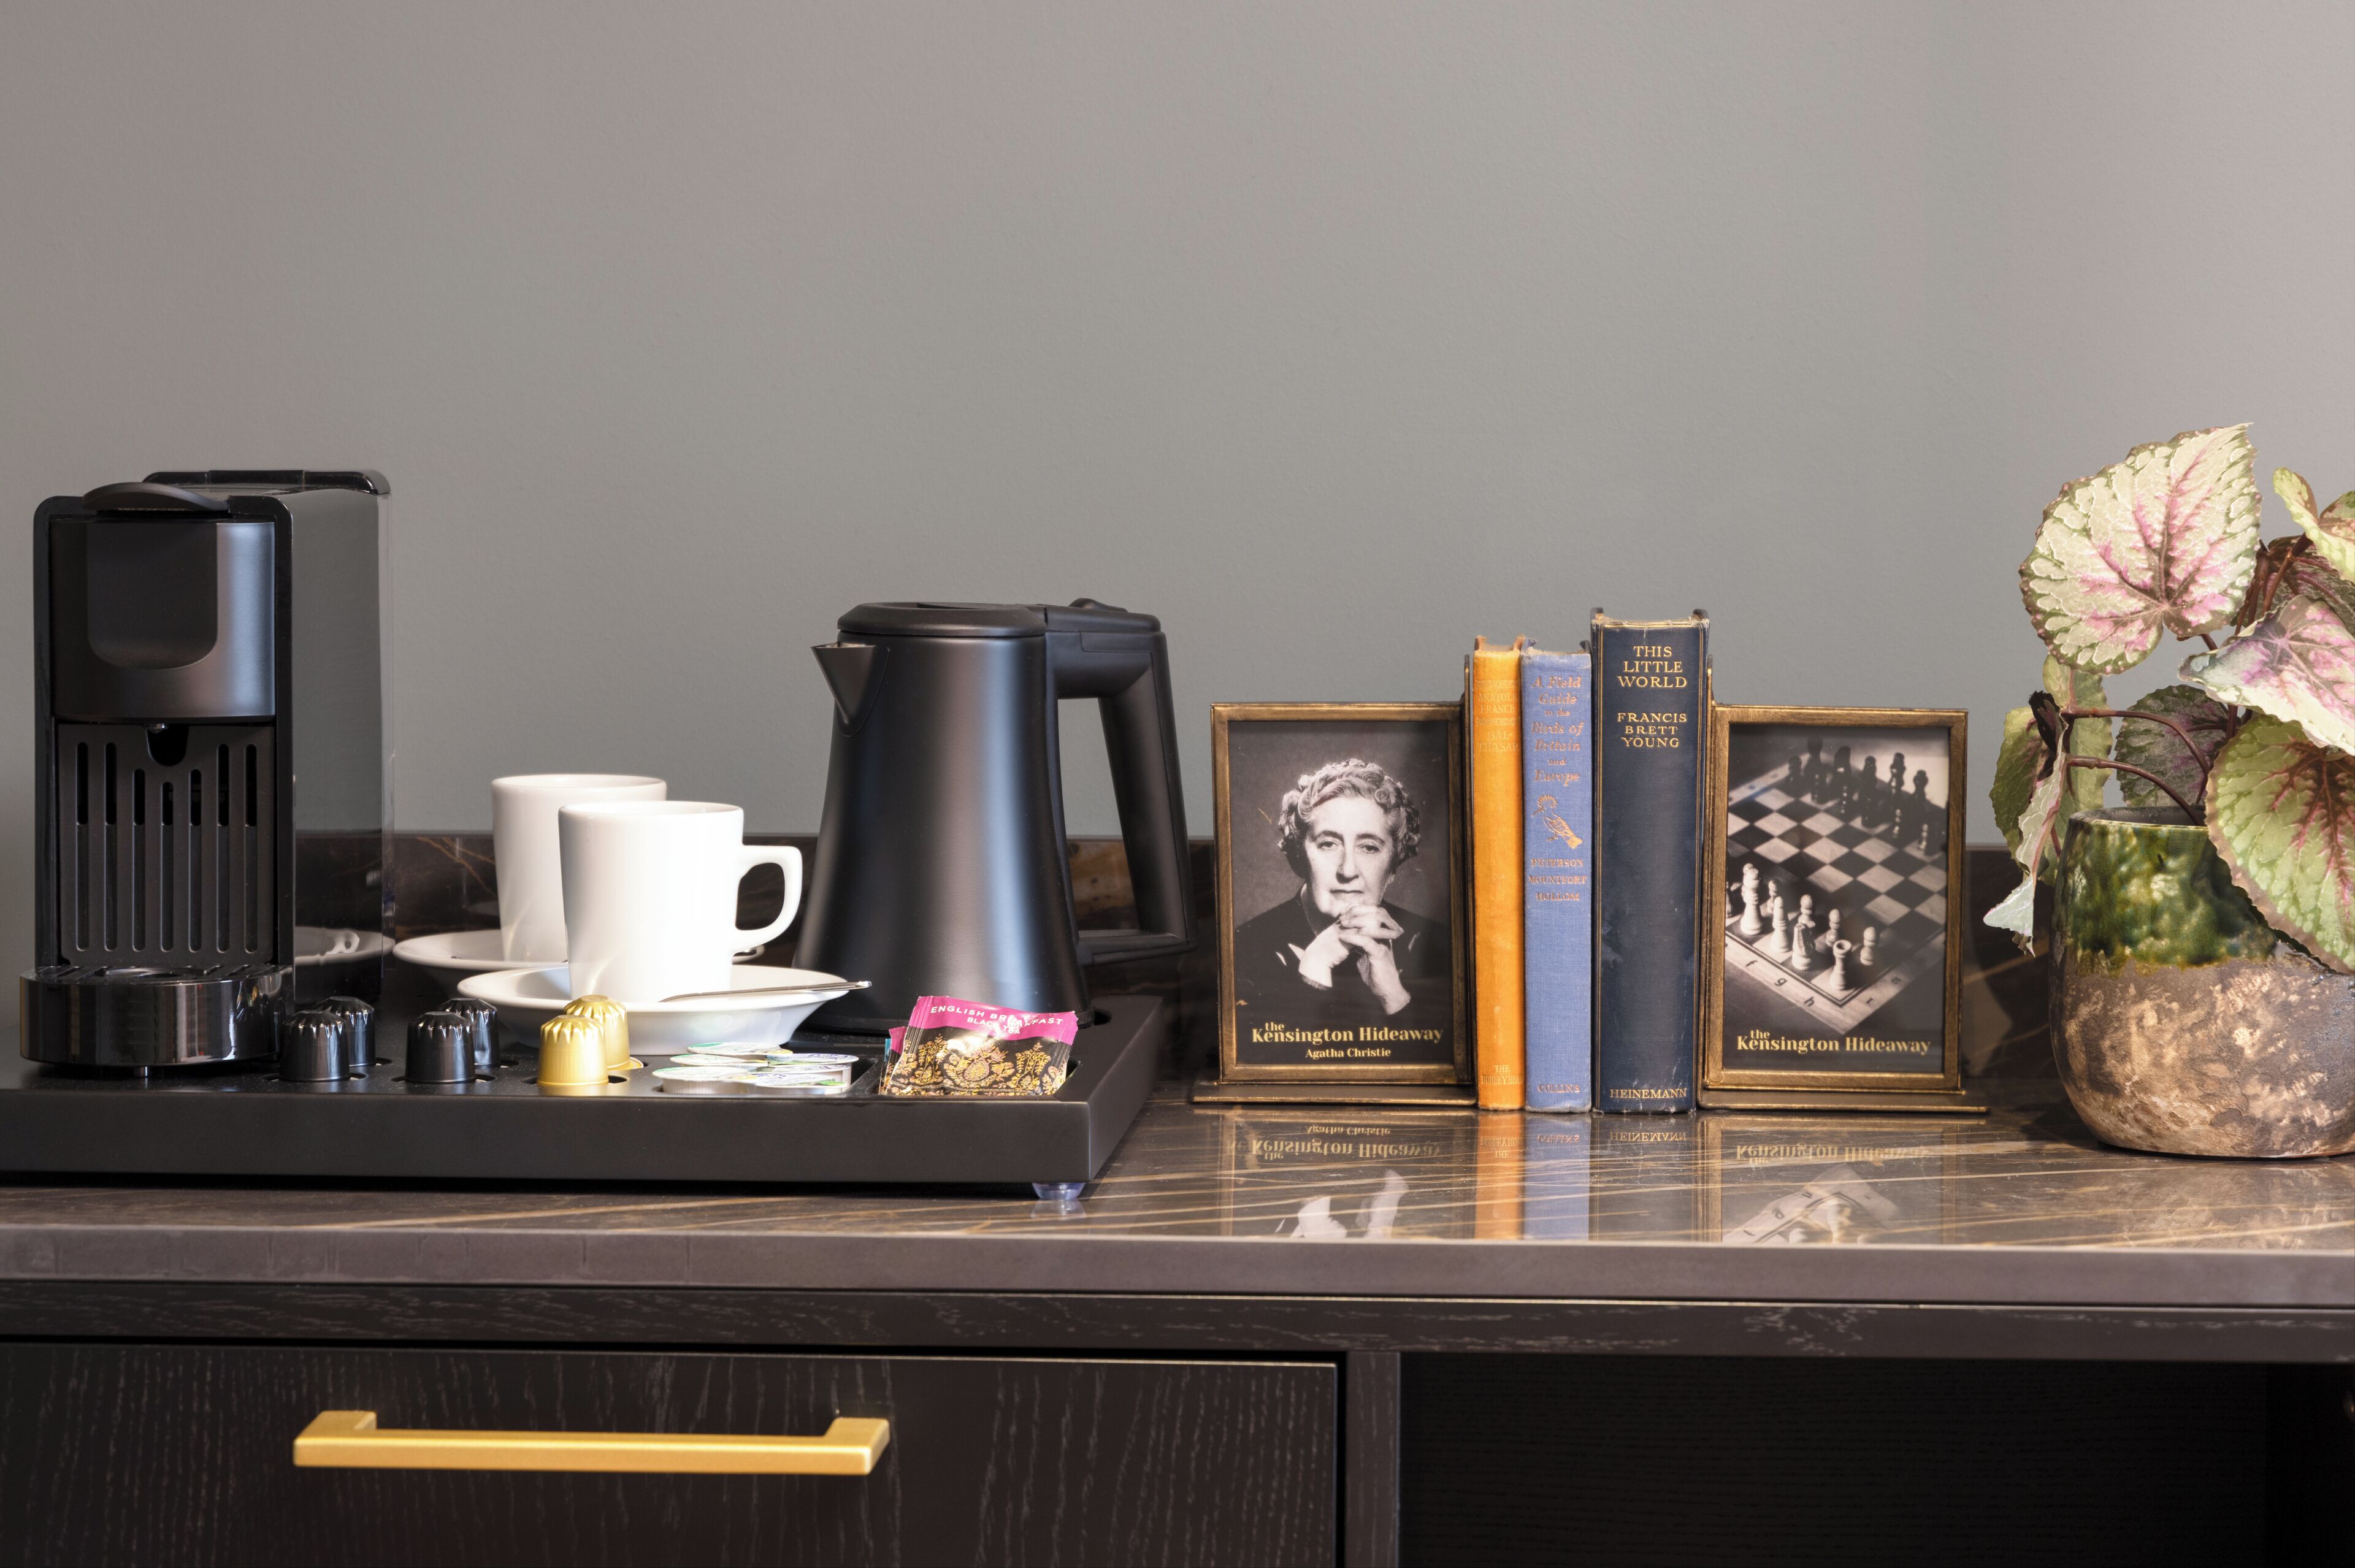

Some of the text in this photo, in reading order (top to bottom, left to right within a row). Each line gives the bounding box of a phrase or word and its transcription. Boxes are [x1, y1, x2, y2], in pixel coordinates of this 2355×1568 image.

[1633, 646, 1672, 657] THIS
[1623, 660, 1683, 673] LITTLE
[1531, 676, 1582, 687] A Field
[1617, 676, 1687, 688] WORLD
[1479, 692, 1517, 702] ANATOLE
[1538, 691, 1578, 704] Guide
[1480, 704, 1515, 713] FRANCE
[1617, 713, 1687, 723] FRANCIS
[1531, 721, 1585, 736] Birds of
[1625, 725, 1678, 735] BRETT
[1534, 739, 1580, 751] Britain
[1620, 737, 1680, 748] YOUNG
[1534, 769, 1580, 786] Europe
[1531, 858, 1583, 867] PETERSON
[930, 1005, 985, 1017] ENGLISH
[1265, 1022, 1285, 1032] the
[1252, 1027, 1444, 1046] Kensington Hideaway
[1750, 1030, 1770, 1039] the
[1737, 1036, 1931, 1055] Kensington Hideaway
[1305, 1047, 1392, 1060] Agatha Christie
[1495, 1064, 1511, 1073] THE
[1481, 1075, 1507, 1085] BODLEY
[1537, 1084, 1580, 1093] COLLINS
[1610, 1088, 1687, 1098] HEINEMANN
